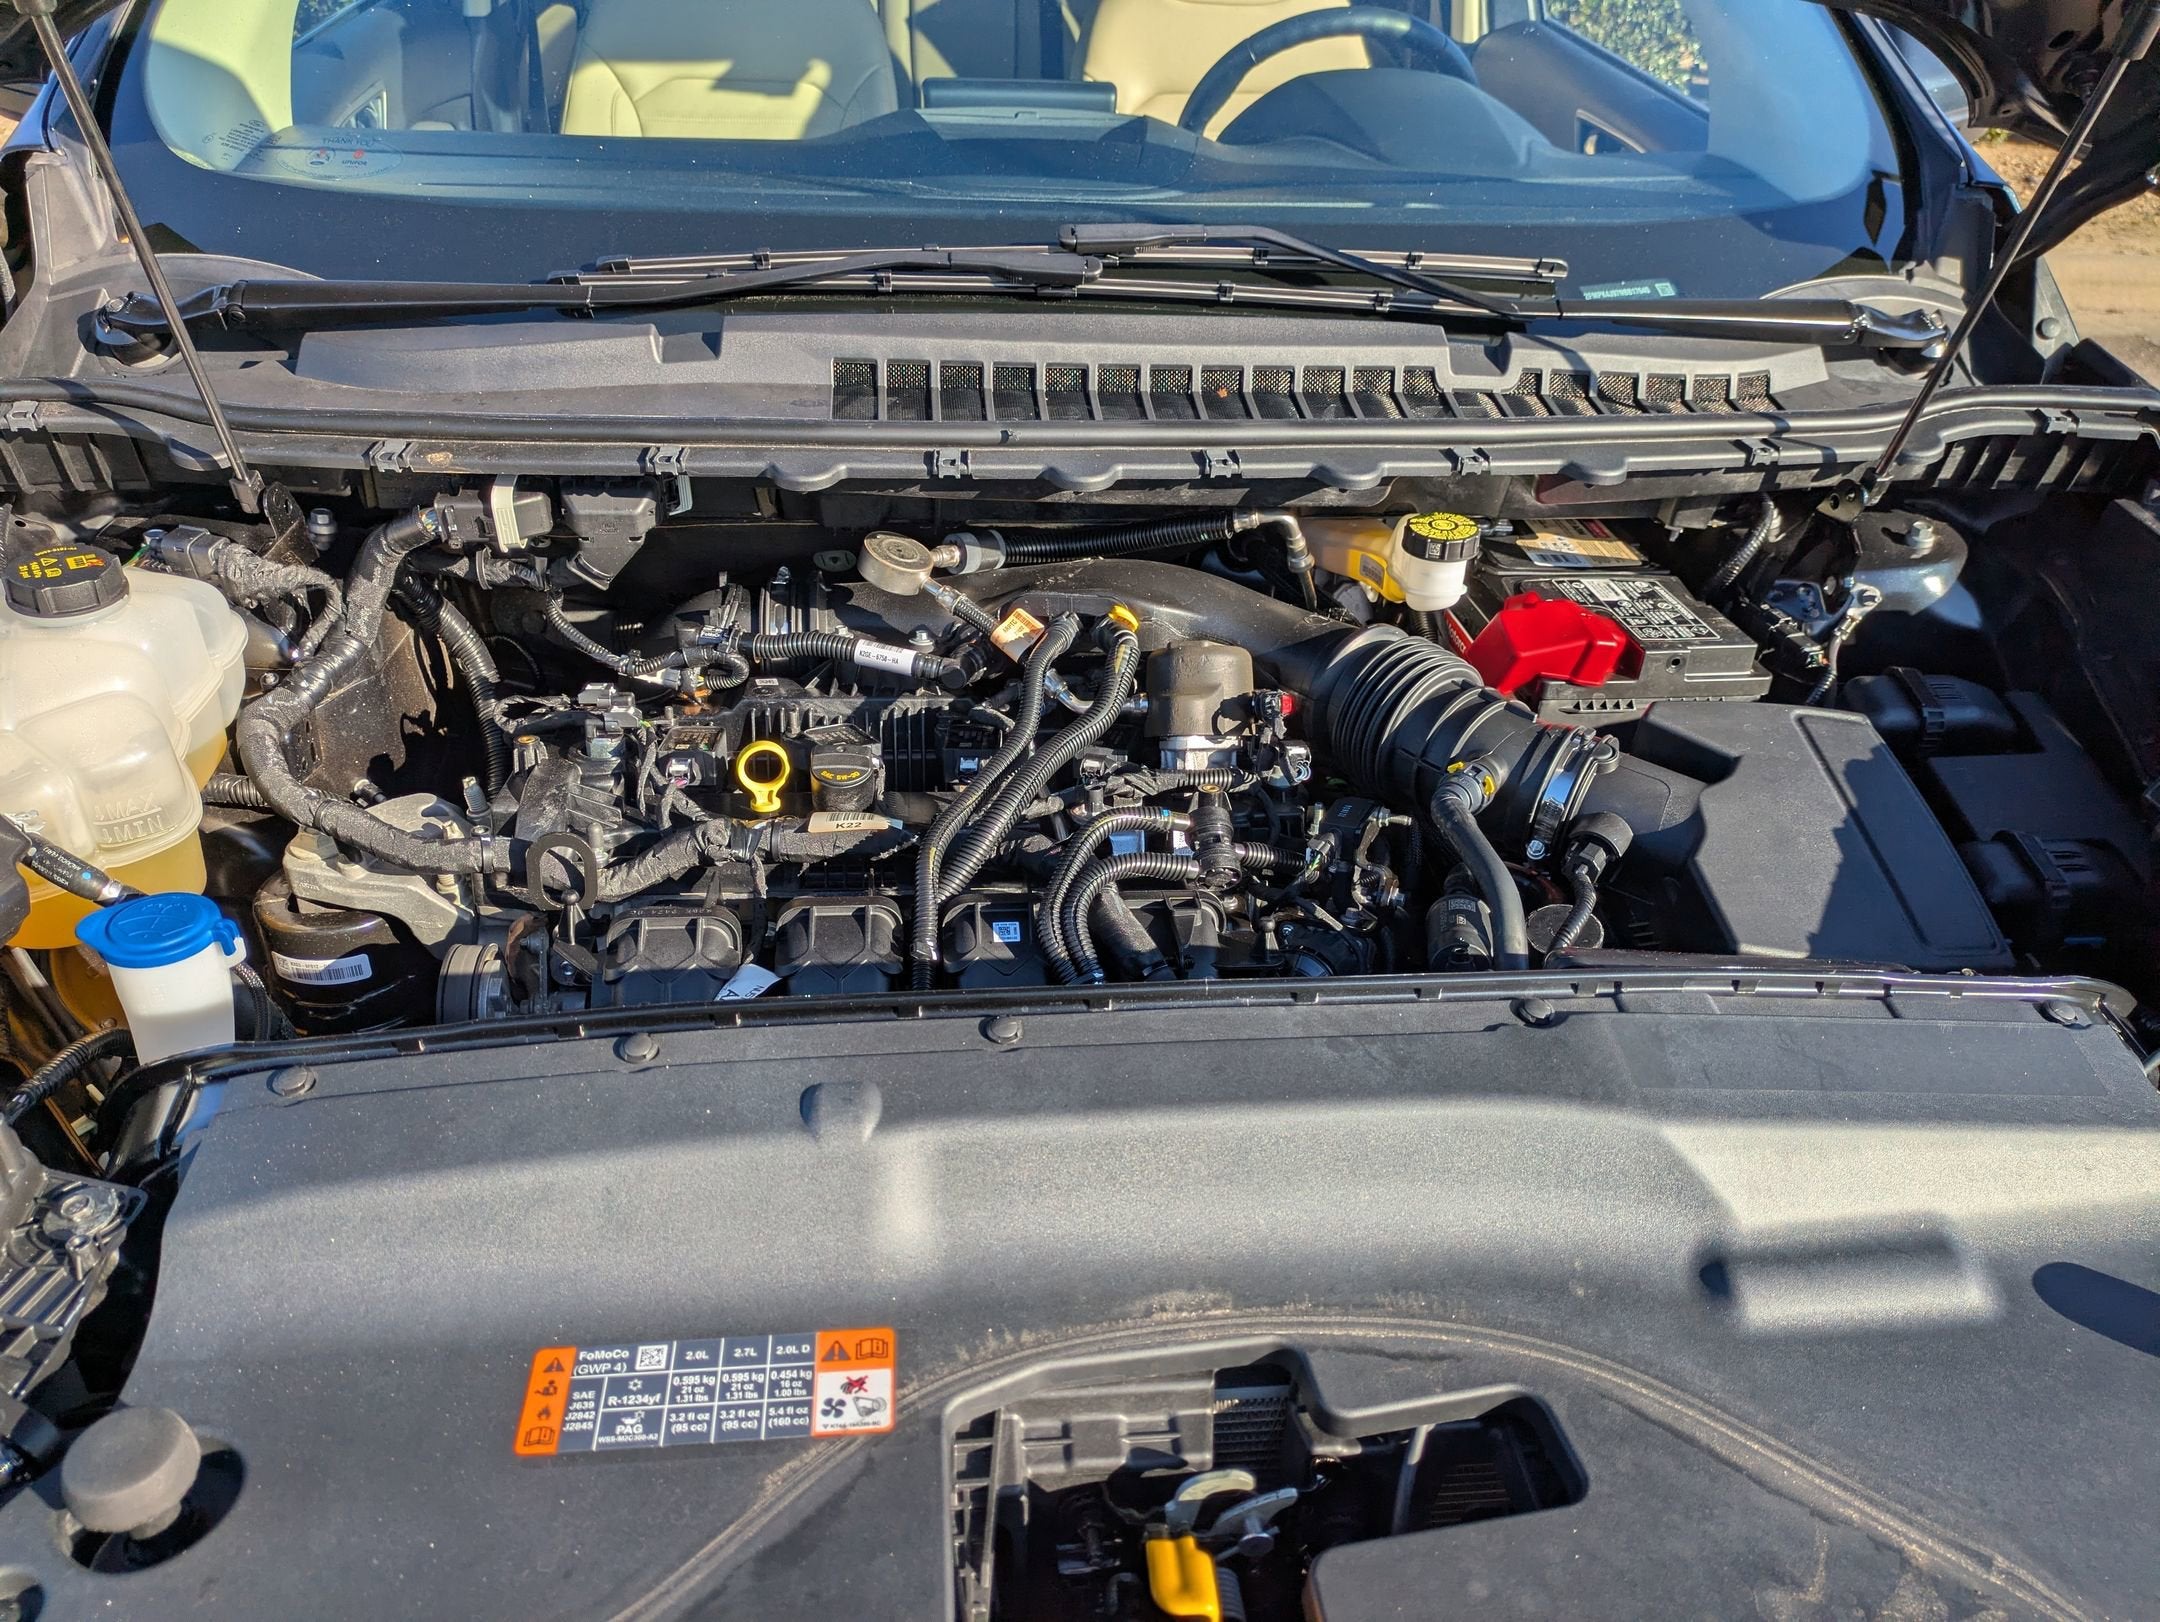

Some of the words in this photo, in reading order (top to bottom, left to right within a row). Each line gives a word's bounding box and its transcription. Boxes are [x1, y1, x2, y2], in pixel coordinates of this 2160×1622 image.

[835, 821, 862, 829] K22
[733, 1347, 758, 1357] 2.7L
[776, 1345, 799, 1355] 2.0L
[801, 1344, 810, 1353] D
[579, 1349, 629, 1361] FoMoCo
[685, 1350, 709, 1360] 2.0L
[573, 1363, 612, 1376] (GWP
[613, 1361, 627, 1374] 4)
[722, 1373, 750, 1383] 0.595
[751, 1372, 764, 1383] kg
[770, 1370, 799, 1380] 0.454
[799, 1369, 813, 1380] kg
[673, 1376, 701, 1386] 0.595
[702, 1375, 716, 1386] kg
[572, 1391, 596, 1400] SAE
[725, 1392, 743, 1400] 1.31
[744, 1391, 758, 1399] lbs
[793, 1388, 807, 1396] lbs
[608, 1393, 661, 1406] R-1234yf
[675, 1394, 693, 1403] 1.31
[694, 1394, 709, 1402] lbs
[719, 1410, 737, 1419] 3.2
[747, 1410, 760, 1418] oz
[768, 1407, 785, 1416] 5.4
[669, 1413, 686, 1422] 3.2
[697, 1412, 710, 1420] oz
[792, 1416, 810, 1426] cc)
[615, 1424, 643, 1434] PAG
[671, 1424, 689, 1435] (95
[690, 1422, 707, 1433] cc)
[721, 1421, 739, 1432] (95
[740, 1419, 758, 1430] cc)
